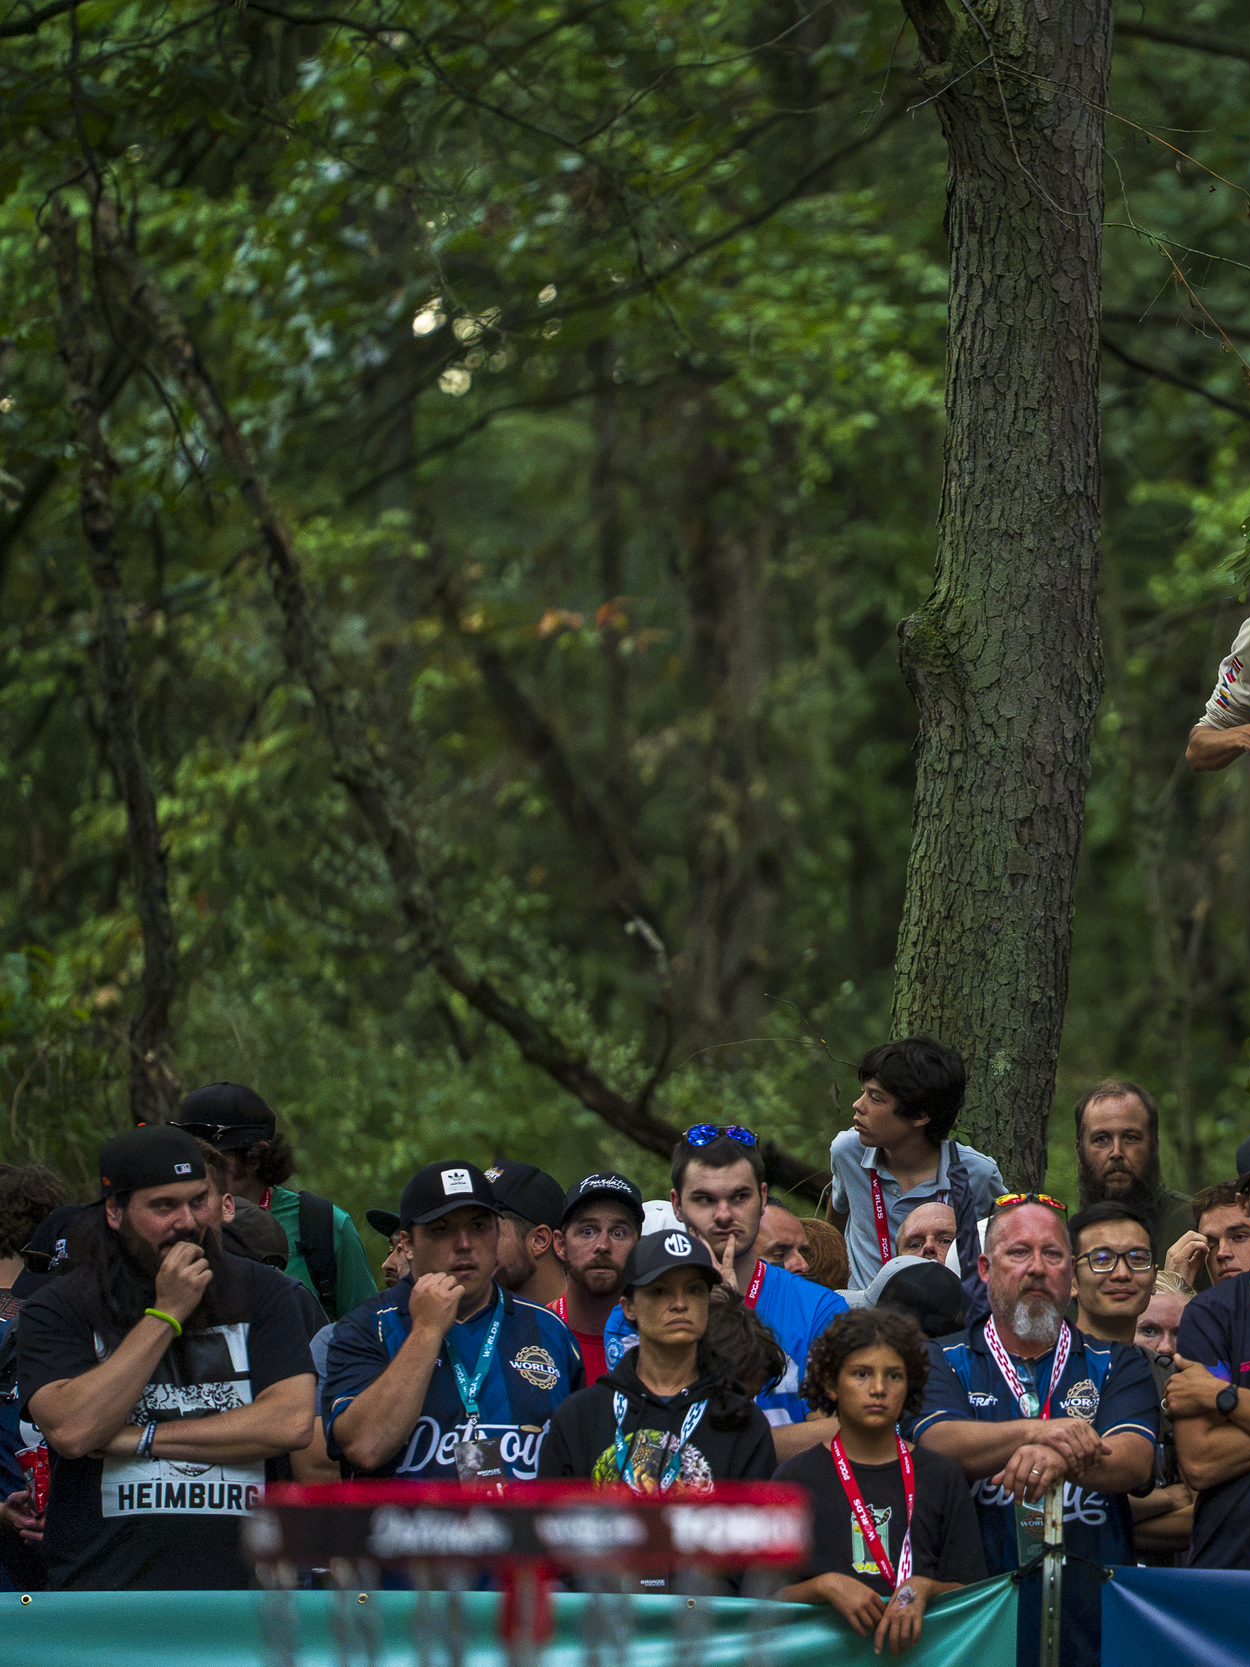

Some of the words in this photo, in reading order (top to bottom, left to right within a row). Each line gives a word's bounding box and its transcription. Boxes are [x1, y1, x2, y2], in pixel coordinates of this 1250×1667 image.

[872, 1178, 884, 1219] WORLDS
[664, 1233, 692, 1257] MG
[749, 1280, 760, 1299] PDGA
[509, 1360, 561, 1378] WORLDS
[118, 1483, 259, 1511] HEIMBURG
[853, 1498, 875, 1541] WORLDS
